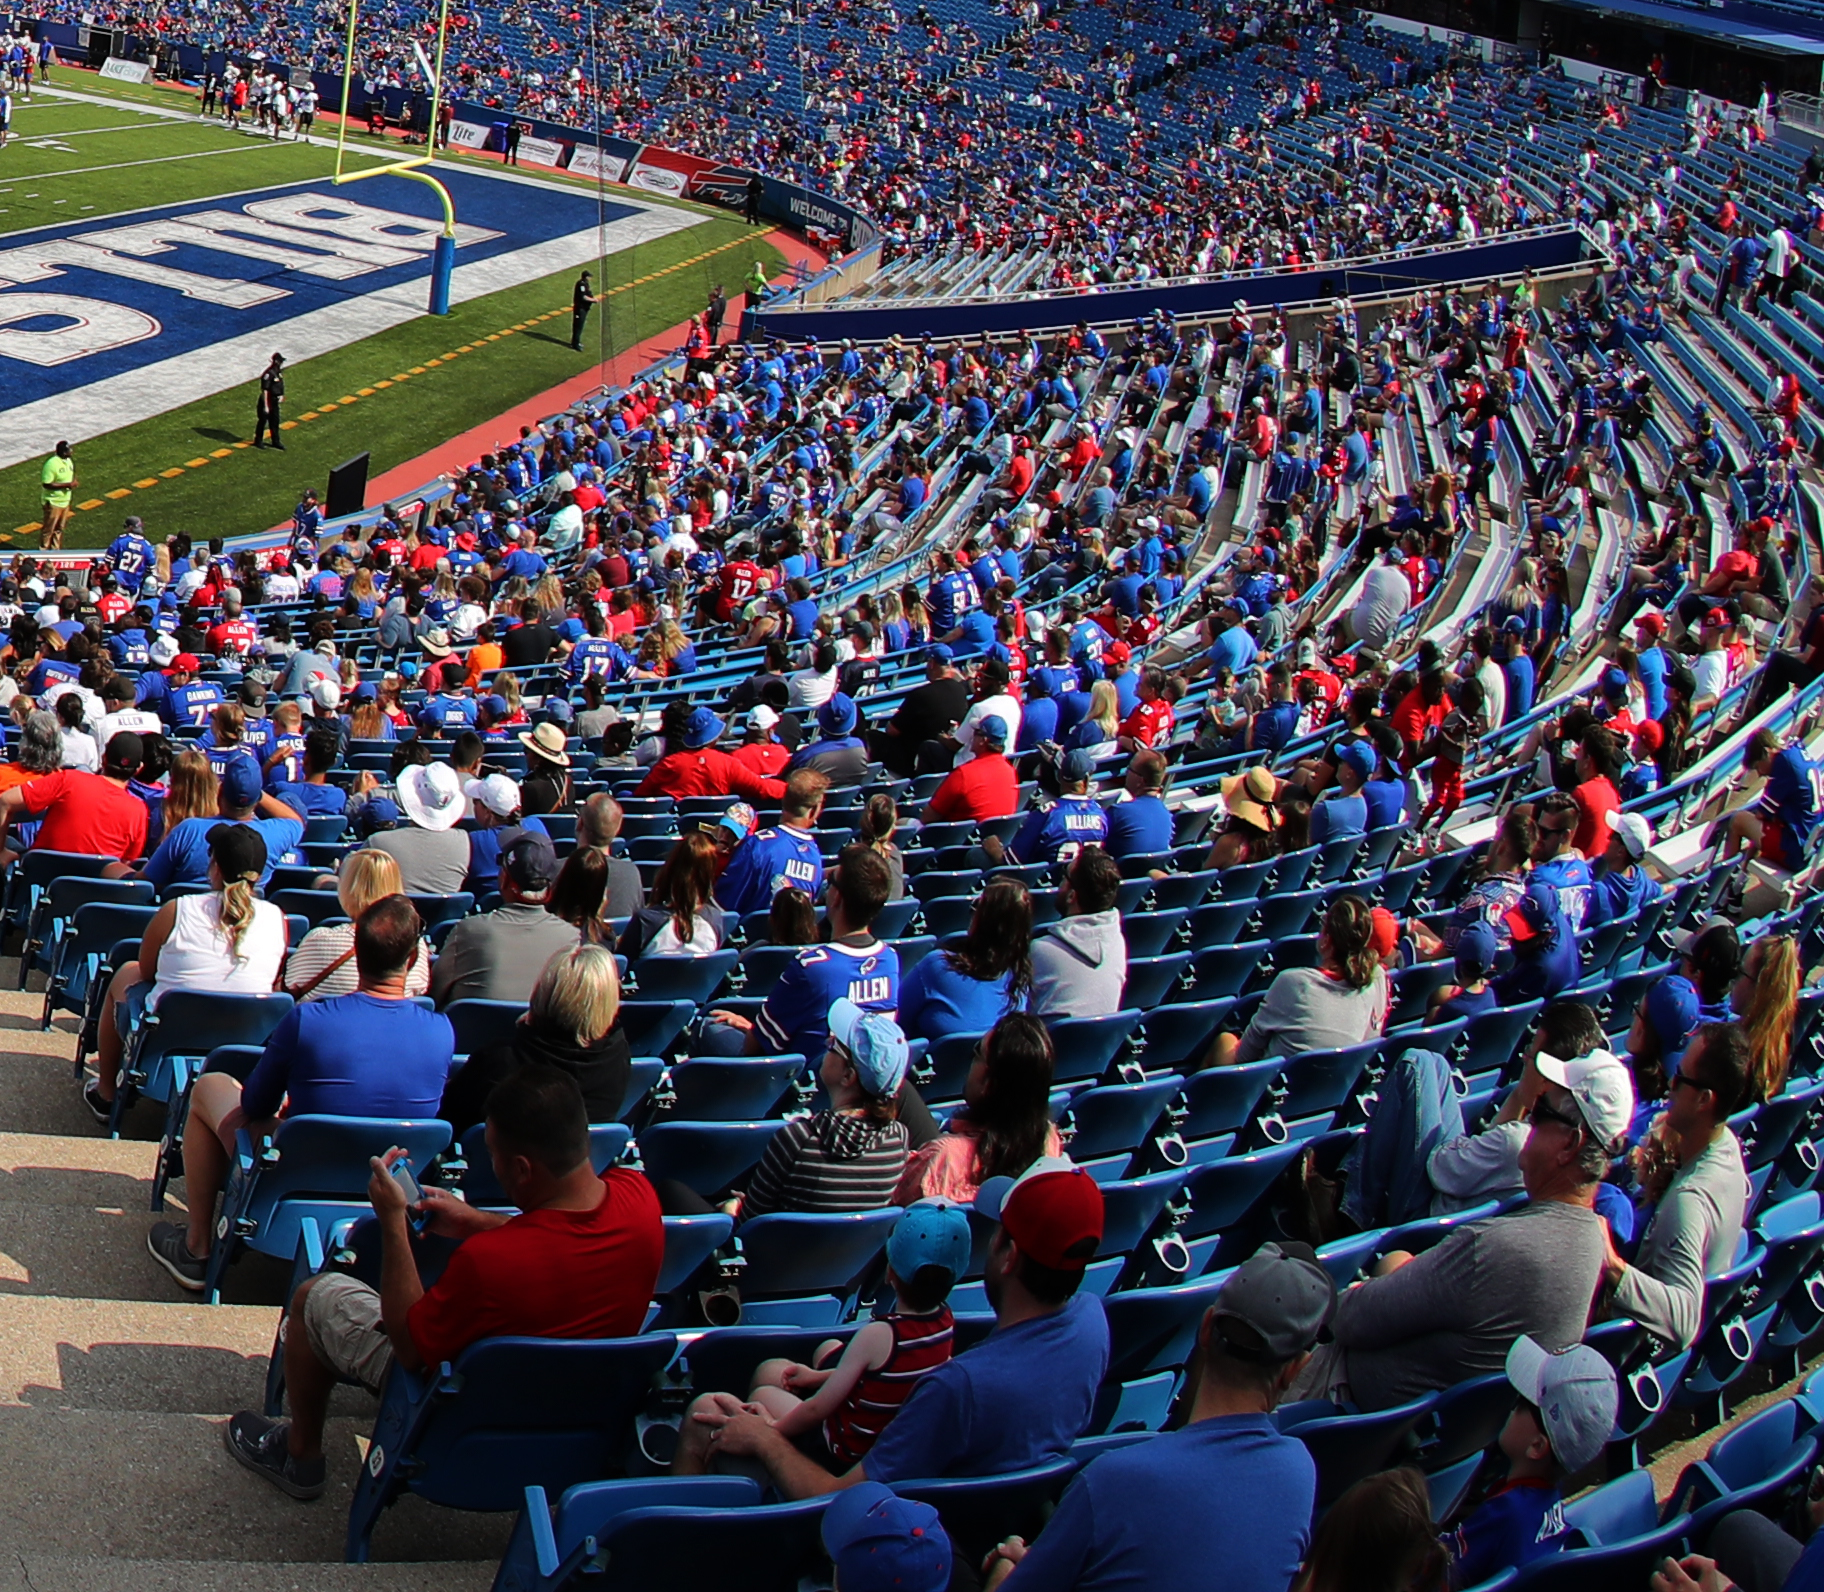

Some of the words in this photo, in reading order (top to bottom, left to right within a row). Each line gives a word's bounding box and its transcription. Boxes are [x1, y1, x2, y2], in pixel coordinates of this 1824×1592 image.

[452, 124, 476, 143] Lite
[790, 197, 837, 230] WELCOME
[121, 551, 143, 571] 27
[732, 579, 752, 599] 17
[106, 609, 127, 624] 17
[227, 624, 248, 636] ALLEN
[582, 657, 611, 677] 17
[116, 715, 144, 726] ALLEN
[444, 709, 464, 722] DIGGS
[1065, 814, 1103, 831] WILLIAMS
[784, 859, 815, 884] ALLEN
[848, 976, 890, 1005] ALLEN
